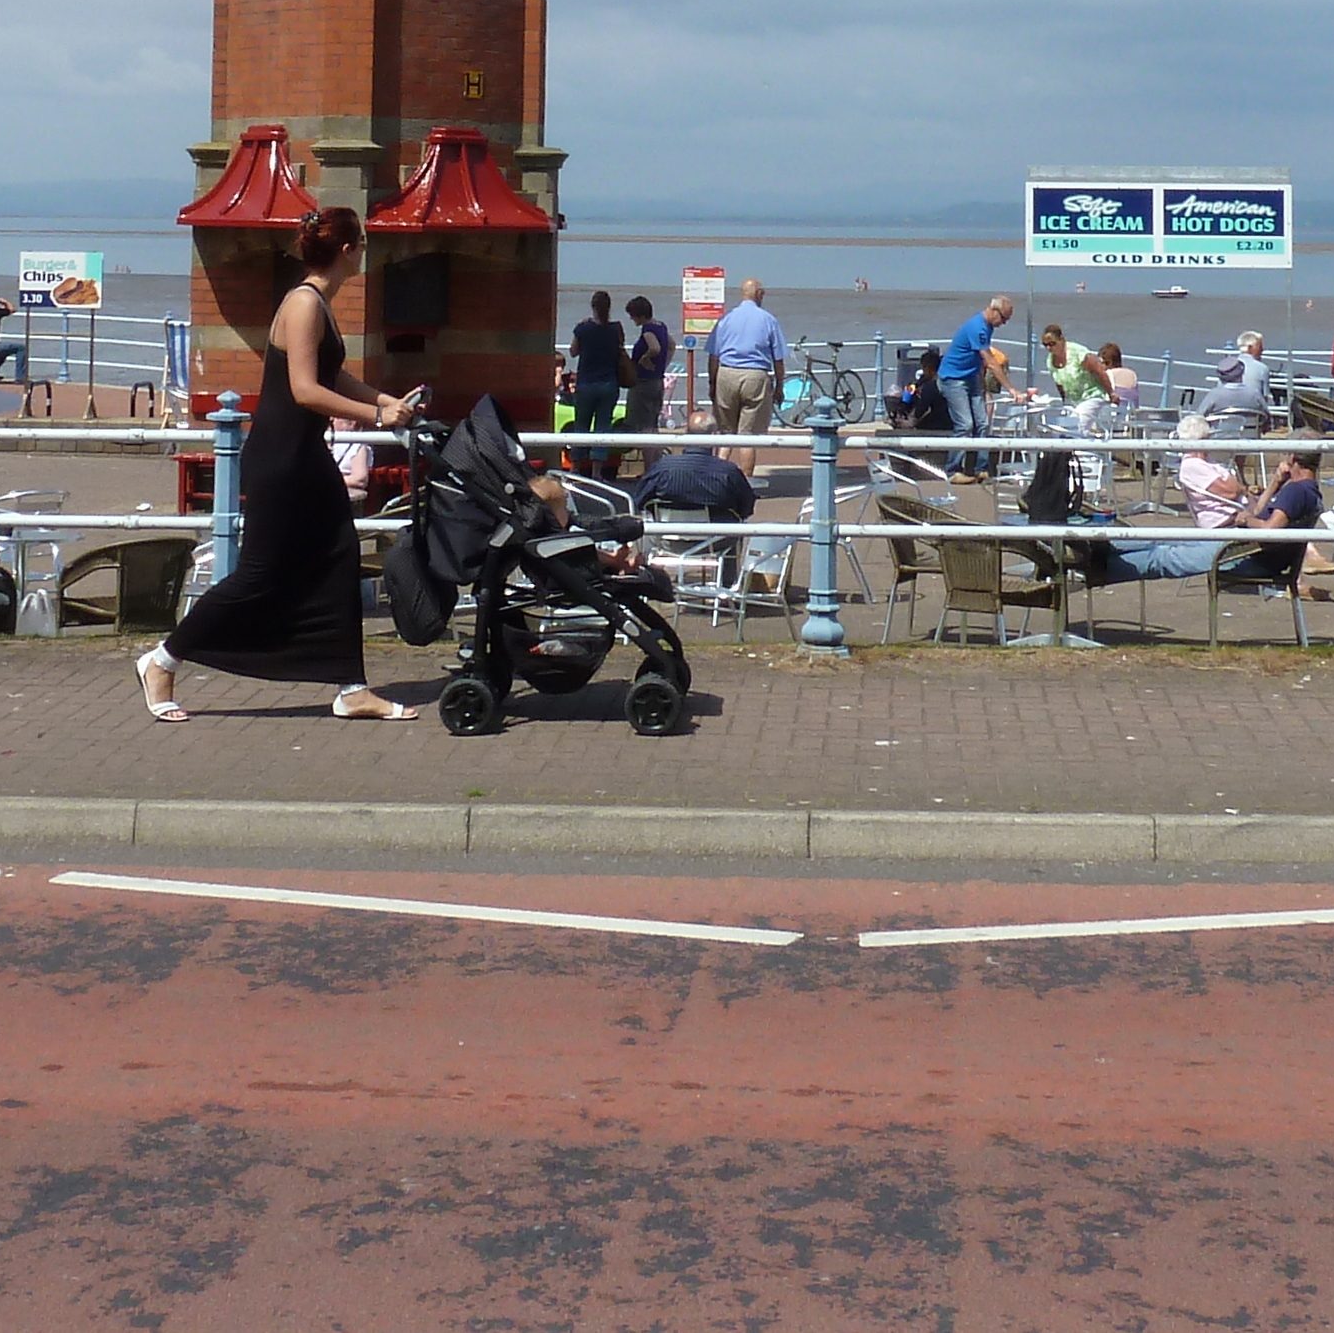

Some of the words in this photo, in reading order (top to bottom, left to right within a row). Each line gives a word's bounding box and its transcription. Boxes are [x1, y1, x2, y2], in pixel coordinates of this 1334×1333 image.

[466, 72, 481, 96] H
[1062, 194, 1123, 217] Soft
[1165, 194, 1277, 217] American
[1039, 214, 1071, 231] ICE
[1076, 215, 1144, 232] CREAM
[1171, 217, 1215, 233] HOT
[1219, 217, 1276, 234] DOGS
[1041, 238, 1079, 249] £1.50
[1236, 240, 1274, 251] £2.20
[1091, 253, 1144, 265] COLD
[1151, 253, 1227, 265] DRINKS
[23, 271, 64, 284] Chips
[22, 293, 44, 304] 3.30
